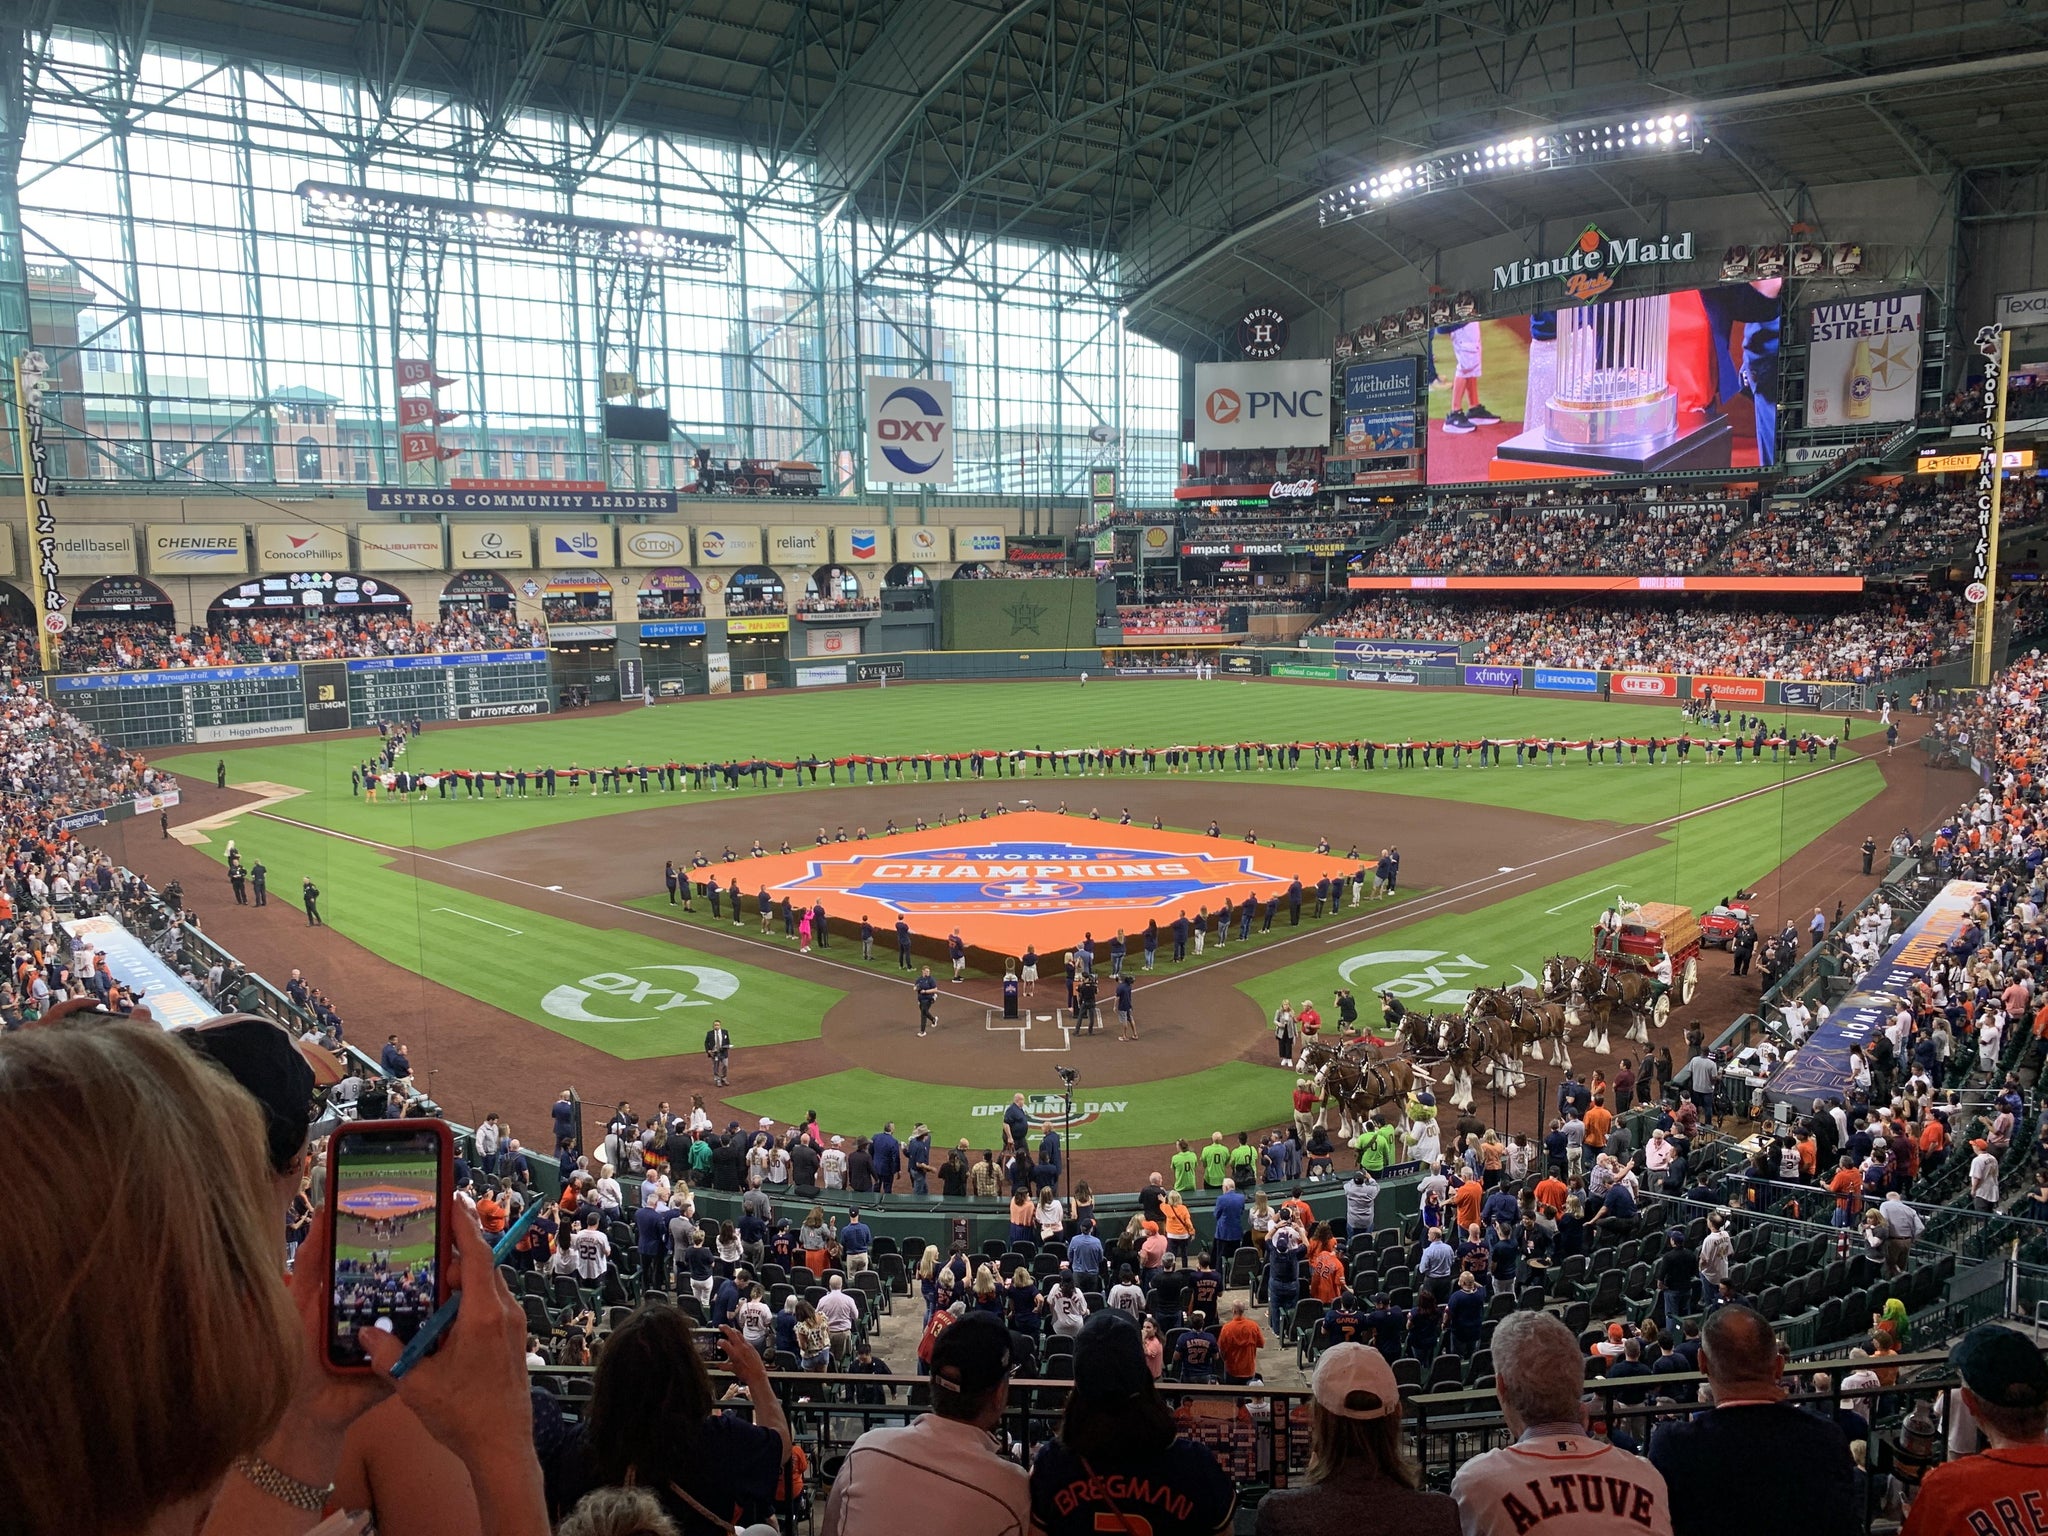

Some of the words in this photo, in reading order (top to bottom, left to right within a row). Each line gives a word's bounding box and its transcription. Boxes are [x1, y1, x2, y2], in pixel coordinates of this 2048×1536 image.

[1723, 245, 1747, 265] 49
[1758, 244, 1782, 264] 24
[1801, 244, 1814, 262] 5
[1840, 243, 1852, 262] 7
[1492, 250, 1600, 292] Minute
[1607, 232, 1694, 266] Maid
[1565, 272, 1613, 301] Park
[1872, 297, 1902, 316] TU
[2002, 295, 2048, 313] Texa
[1243, 308, 1283, 325] HOUSTON
[1254, 325, 1272, 342] H
[1245, 344, 1281, 358] ASTROS
[404, 364, 425, 379] 05
[612, 378, 628, 391] 17
[1350, 374, 1411, 395] Methodist
[1982, 362, 1999, 419] ROOT
[408, 403, 428, 417] 19
[1246, 390, 1323, 419] PNC
[877, 419, 946, 442] OXY
[1978, 423, 1994, 442] 4
[409, 439, 428, 453] 21
[1811, 447, 1850, 462] NABO
[1943, 456, 1972, 468] RENT
[1976, 445, 1993, 490] THA
[467, 481, 536, 489] MINUTE
[551, 482, 593, 490] MAID
[380, 493, 456, 506] ASTROS
[465, 494, 583, 508] COMMUNITY
[592, 495, 668, 509] LEADERS
[1201, 499, 1238, 507] HORNITOS
[37, 498, 55, 533] IZ
[157, 537, 238, 548] CHENIERE
[572, 532, 598, 549] slb
[776, 536, 816, 548] reliant
[973, 536, 1000, 550] LNG
[1974, 494, 1991, 580] CHIKIN
[364, 542, 438, 550] HALLIBURTON
[702, 541, 725, 549] OXY
[1190, 545, 1230, 556] impact
[1242, 543, 1282, 555] impact
[1305, 543, 1345, 552] PLUCKERS
[264, 550, 343, 560] ConocoPhillips
[462, 550, 522, 559] LEXUS
[1008, 548, 1065, 561] Budweiser
[40, 538, 62, 610] FAIR
[103, 588, 142, 596] LANDRY'S
[650, 623, 698, 633] 1POINTFIVE
[826, 639, 840, 648] 66
[156, 672, 189, 681] Through
[190, 672, 197, 680] it
[198, 672, 208, 680] all.
[1283, 668, 1305, 676] National
[1475, 669, 1511, 686] xfinity
[1547, 676, 1595, 686] HONDA
[184, 687, 194, 740] NATIONAL
[309, 701, 346, 711] BETMGM
[470, 703, 537, 718] NITTOTIRE.COM
[229, 725, 293, 737] Higginbotham
[60, 812, 99, 829] AmegyBank
[976, 853, 1089, 861] WORLD
[872, 863, 1192, 878] CHAMPIONS
[1003, 883, 1061, 896] H
[1371, 953, 1490, 998] OXY
[578, 972, 713, 1011] OXY
[1839, 1006, 1882, 1040] HOME
[1868, 989, 1896, 1003] OF
[1882, 969, 1914, 987] THE
[971, 1102, 1077, 1117] OPNING
[1084, 1101, 1129, 1112] DAY
[825, 1160, 839, 1172] 22
[580, 1245, 597, 1260] 22
[1315, 1262, 1331, 1279] 22
[1198, 1288, 1215, 1302] 27
[1063, 1301, 1072, 1314] 2
[1120, 1300, 1132, 1309] 27
[1187, 1348, 1208, 1365] 27
[1054, 1474, 1194, 1522] BREGMAN
[1500, 1473, 1655, 1536] ALTUVE
[1967, 1488, 2048, 1536] BRE
